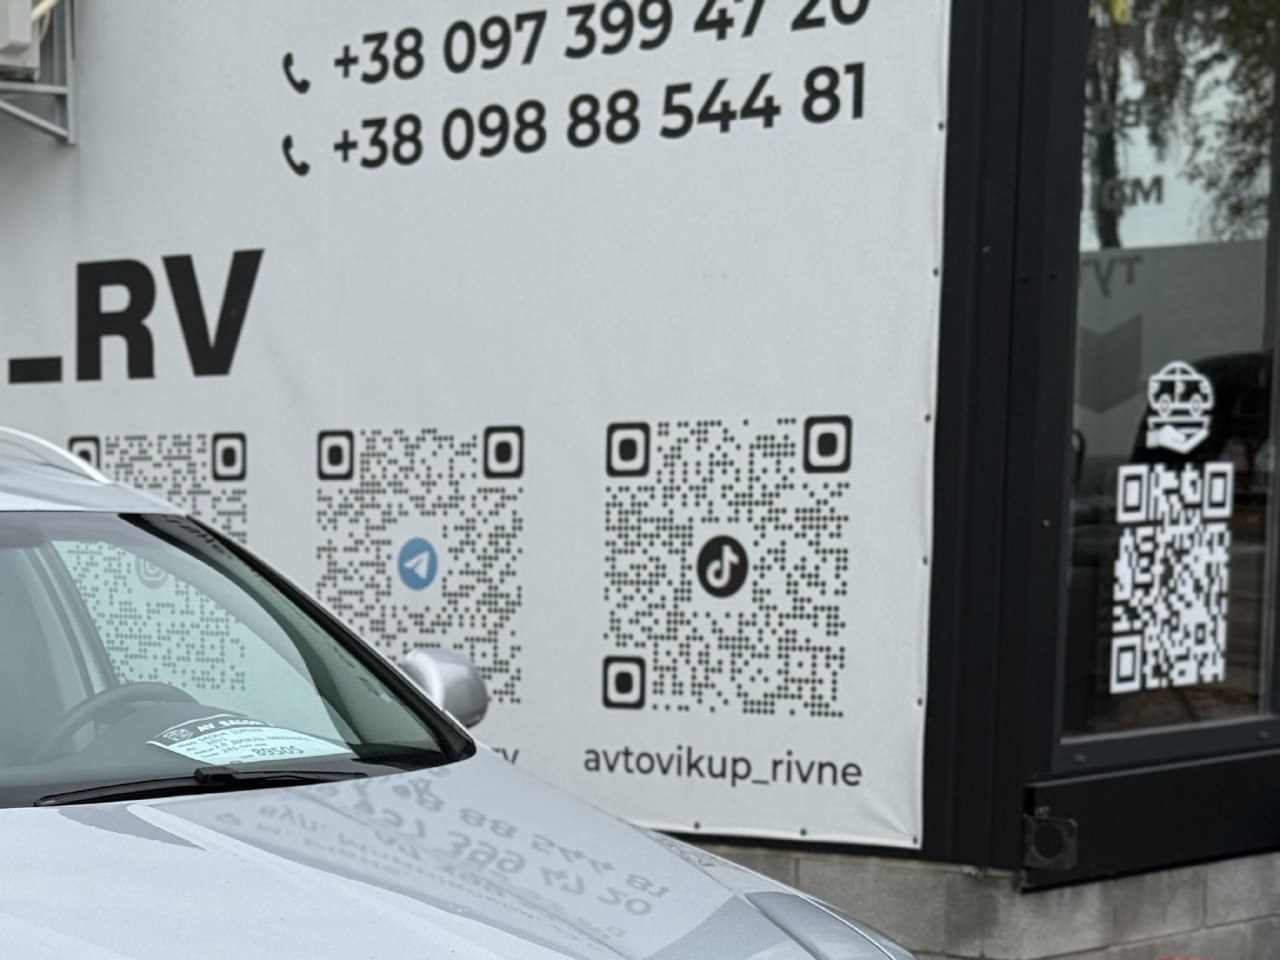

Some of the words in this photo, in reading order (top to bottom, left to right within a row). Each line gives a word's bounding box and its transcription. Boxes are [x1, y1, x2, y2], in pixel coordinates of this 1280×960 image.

[334, 27, 424, 84] +38
[443, 10, 547, 74] 097
[564, 0, 673, 59] 399
[693, 0, 766, 41] 47
[334, 114, 423, 169] +38
[442, 99, 547, 160] 098
[567, 89, 640, 148] 88
[660, 73, 781, 139] 544
[802, 62, 865, 124] 81
[584, 745, 863, 787] avtovikup_rivne
